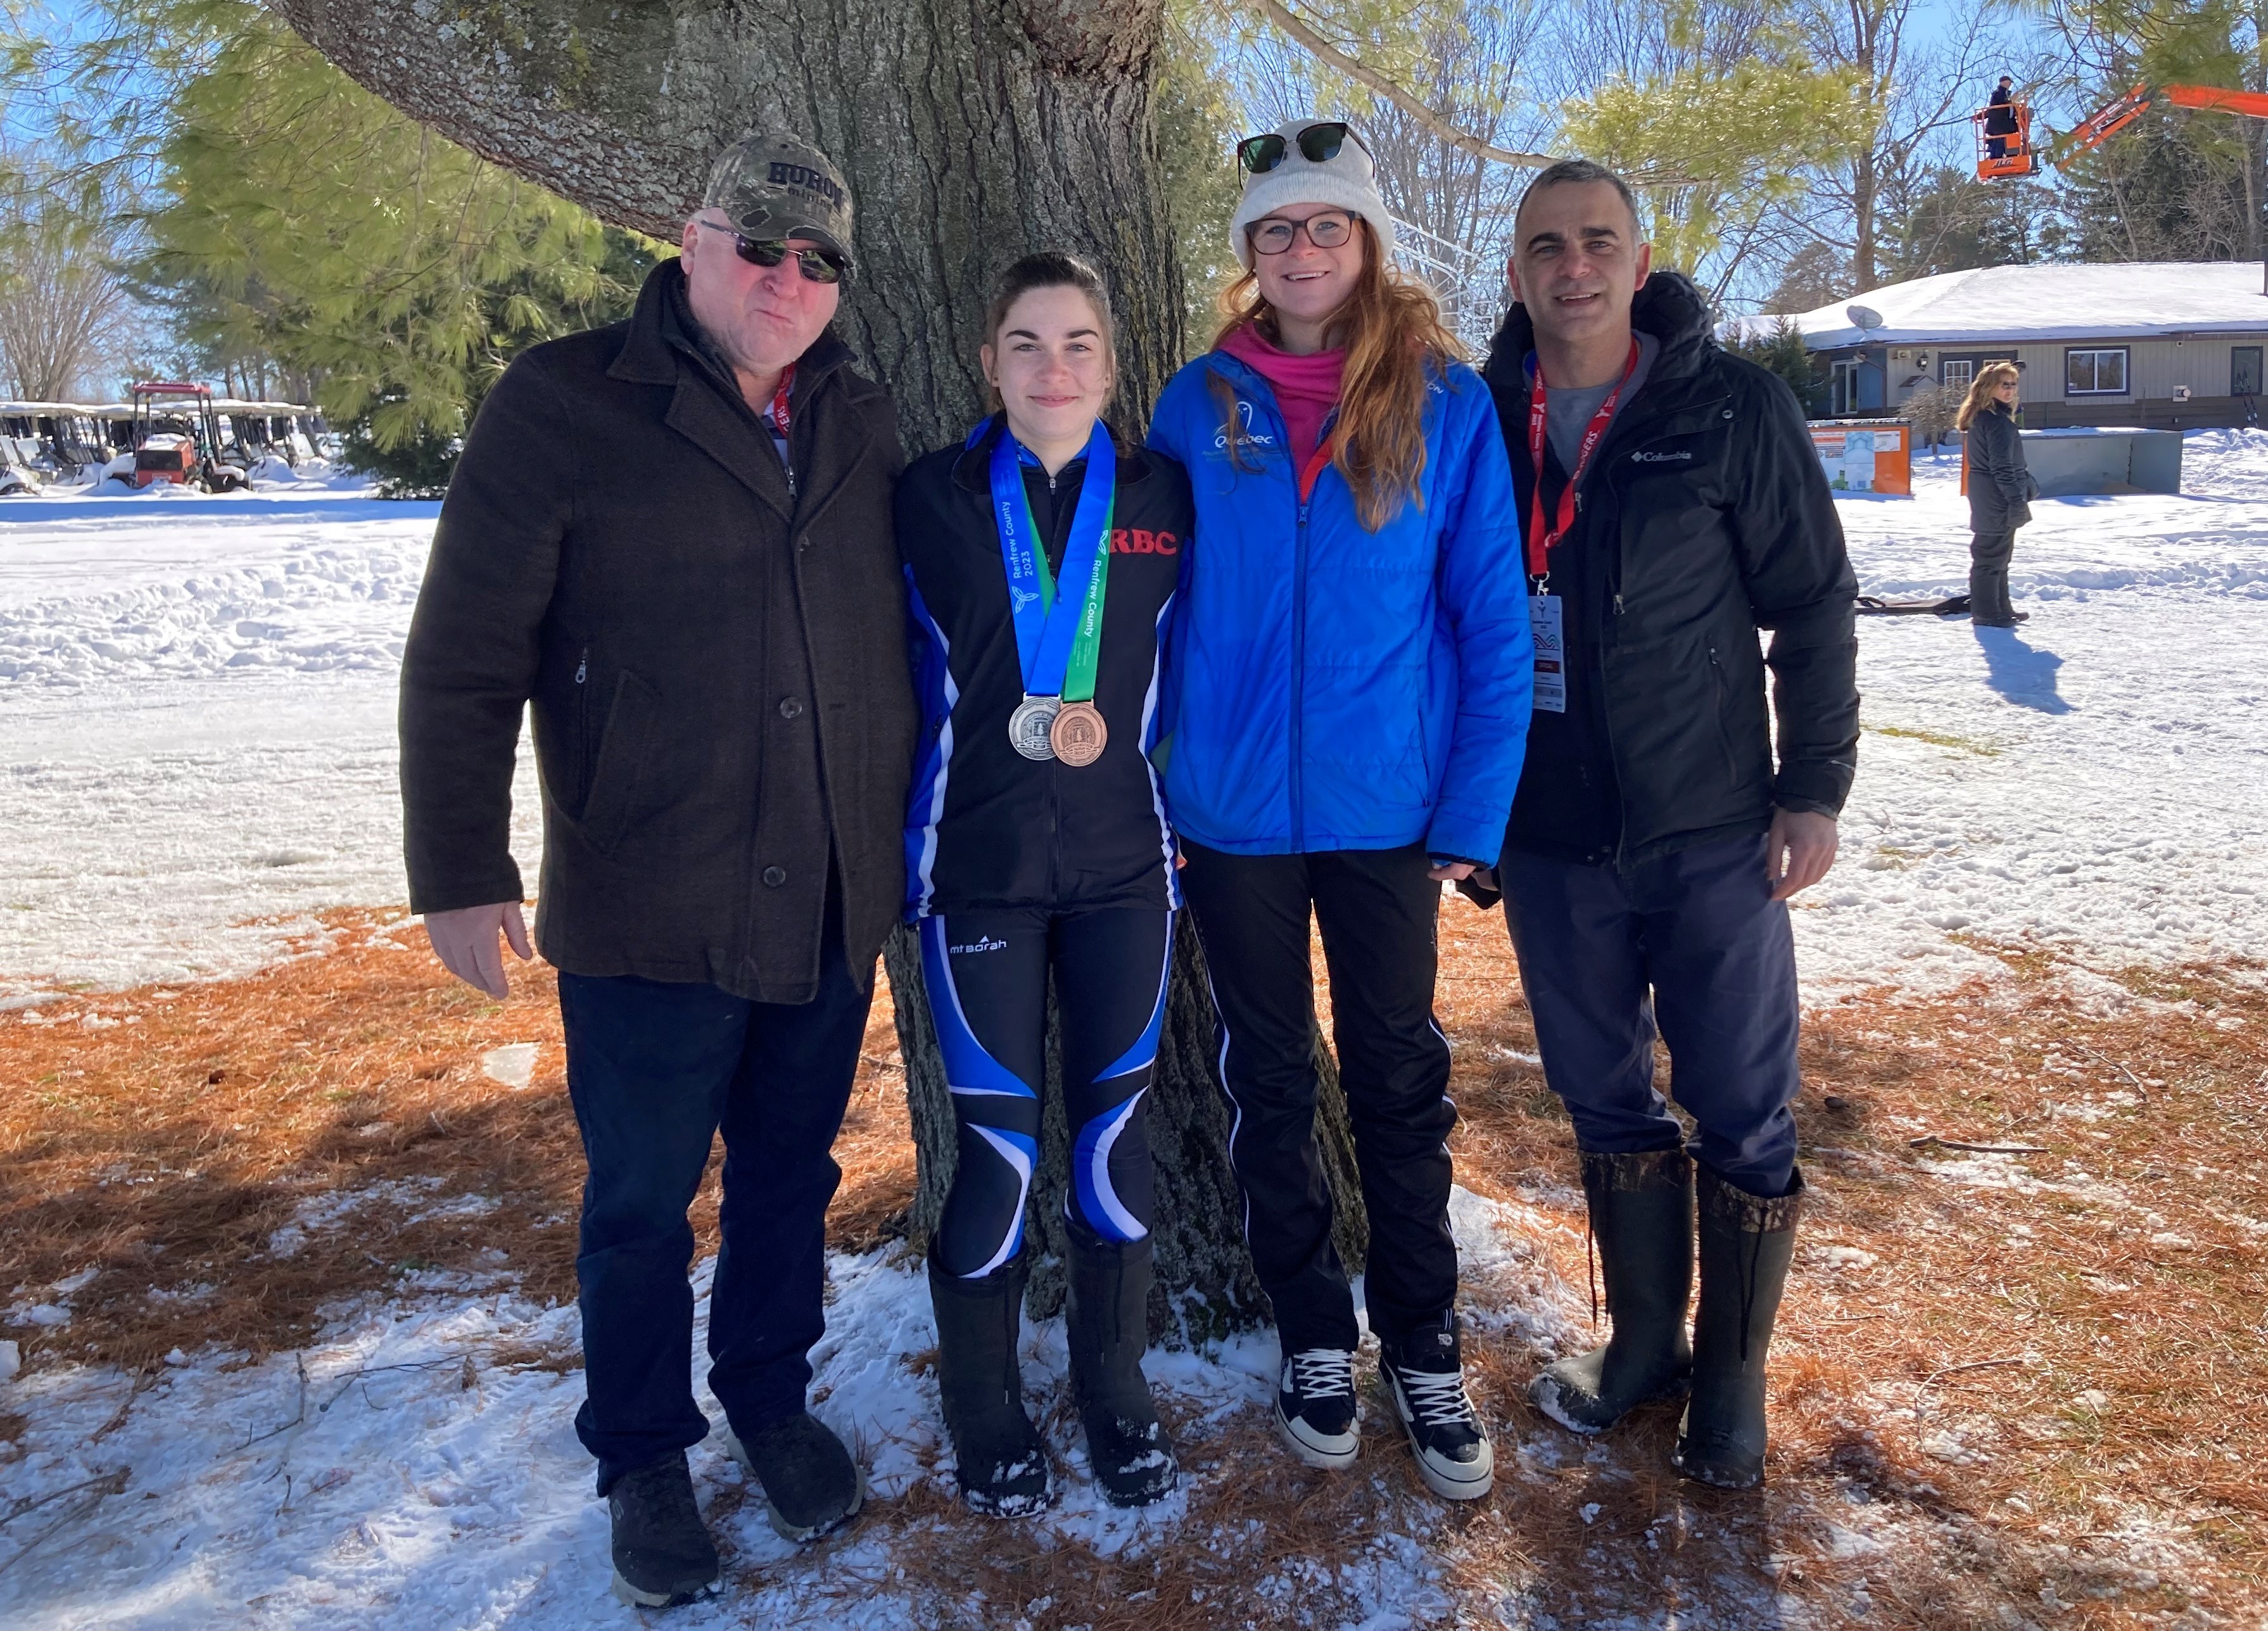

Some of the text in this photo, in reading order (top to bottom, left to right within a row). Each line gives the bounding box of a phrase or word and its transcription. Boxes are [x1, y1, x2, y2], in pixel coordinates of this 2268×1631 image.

[768, 162, 843, 213] HURON
[1001, 501, 1014, 536] County
[1009, 538, 1022, 579] Renfrew
[1020, 550, 1033, 576] 2023
[1084, 559, 1103, 638] Renfrew County
